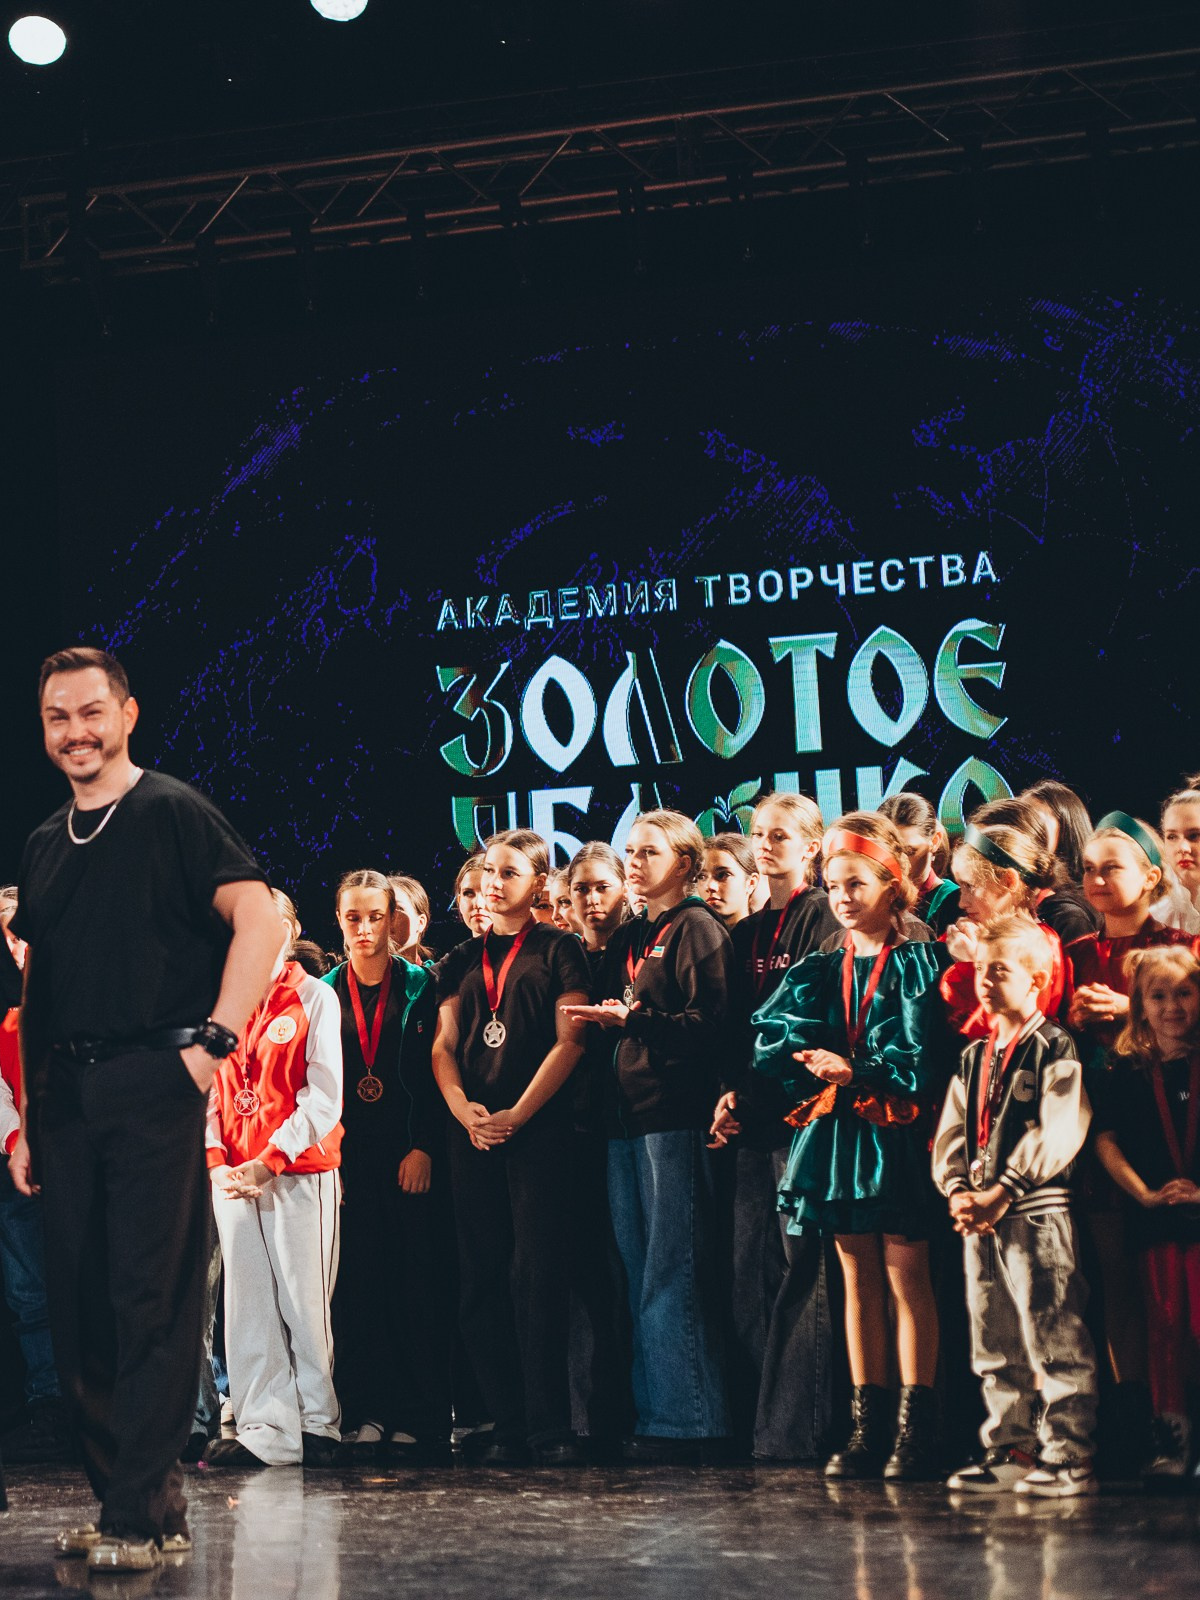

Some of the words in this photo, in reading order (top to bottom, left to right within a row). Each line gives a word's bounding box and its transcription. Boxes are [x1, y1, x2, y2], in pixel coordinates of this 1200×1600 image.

[436, 577, 679, 631] АКАДЕМИЯ
[695, 549, 1002, 608] ТВОРЧЕСТВА
[435, 618, 1009, 778] ЗОЛОТОЕ
